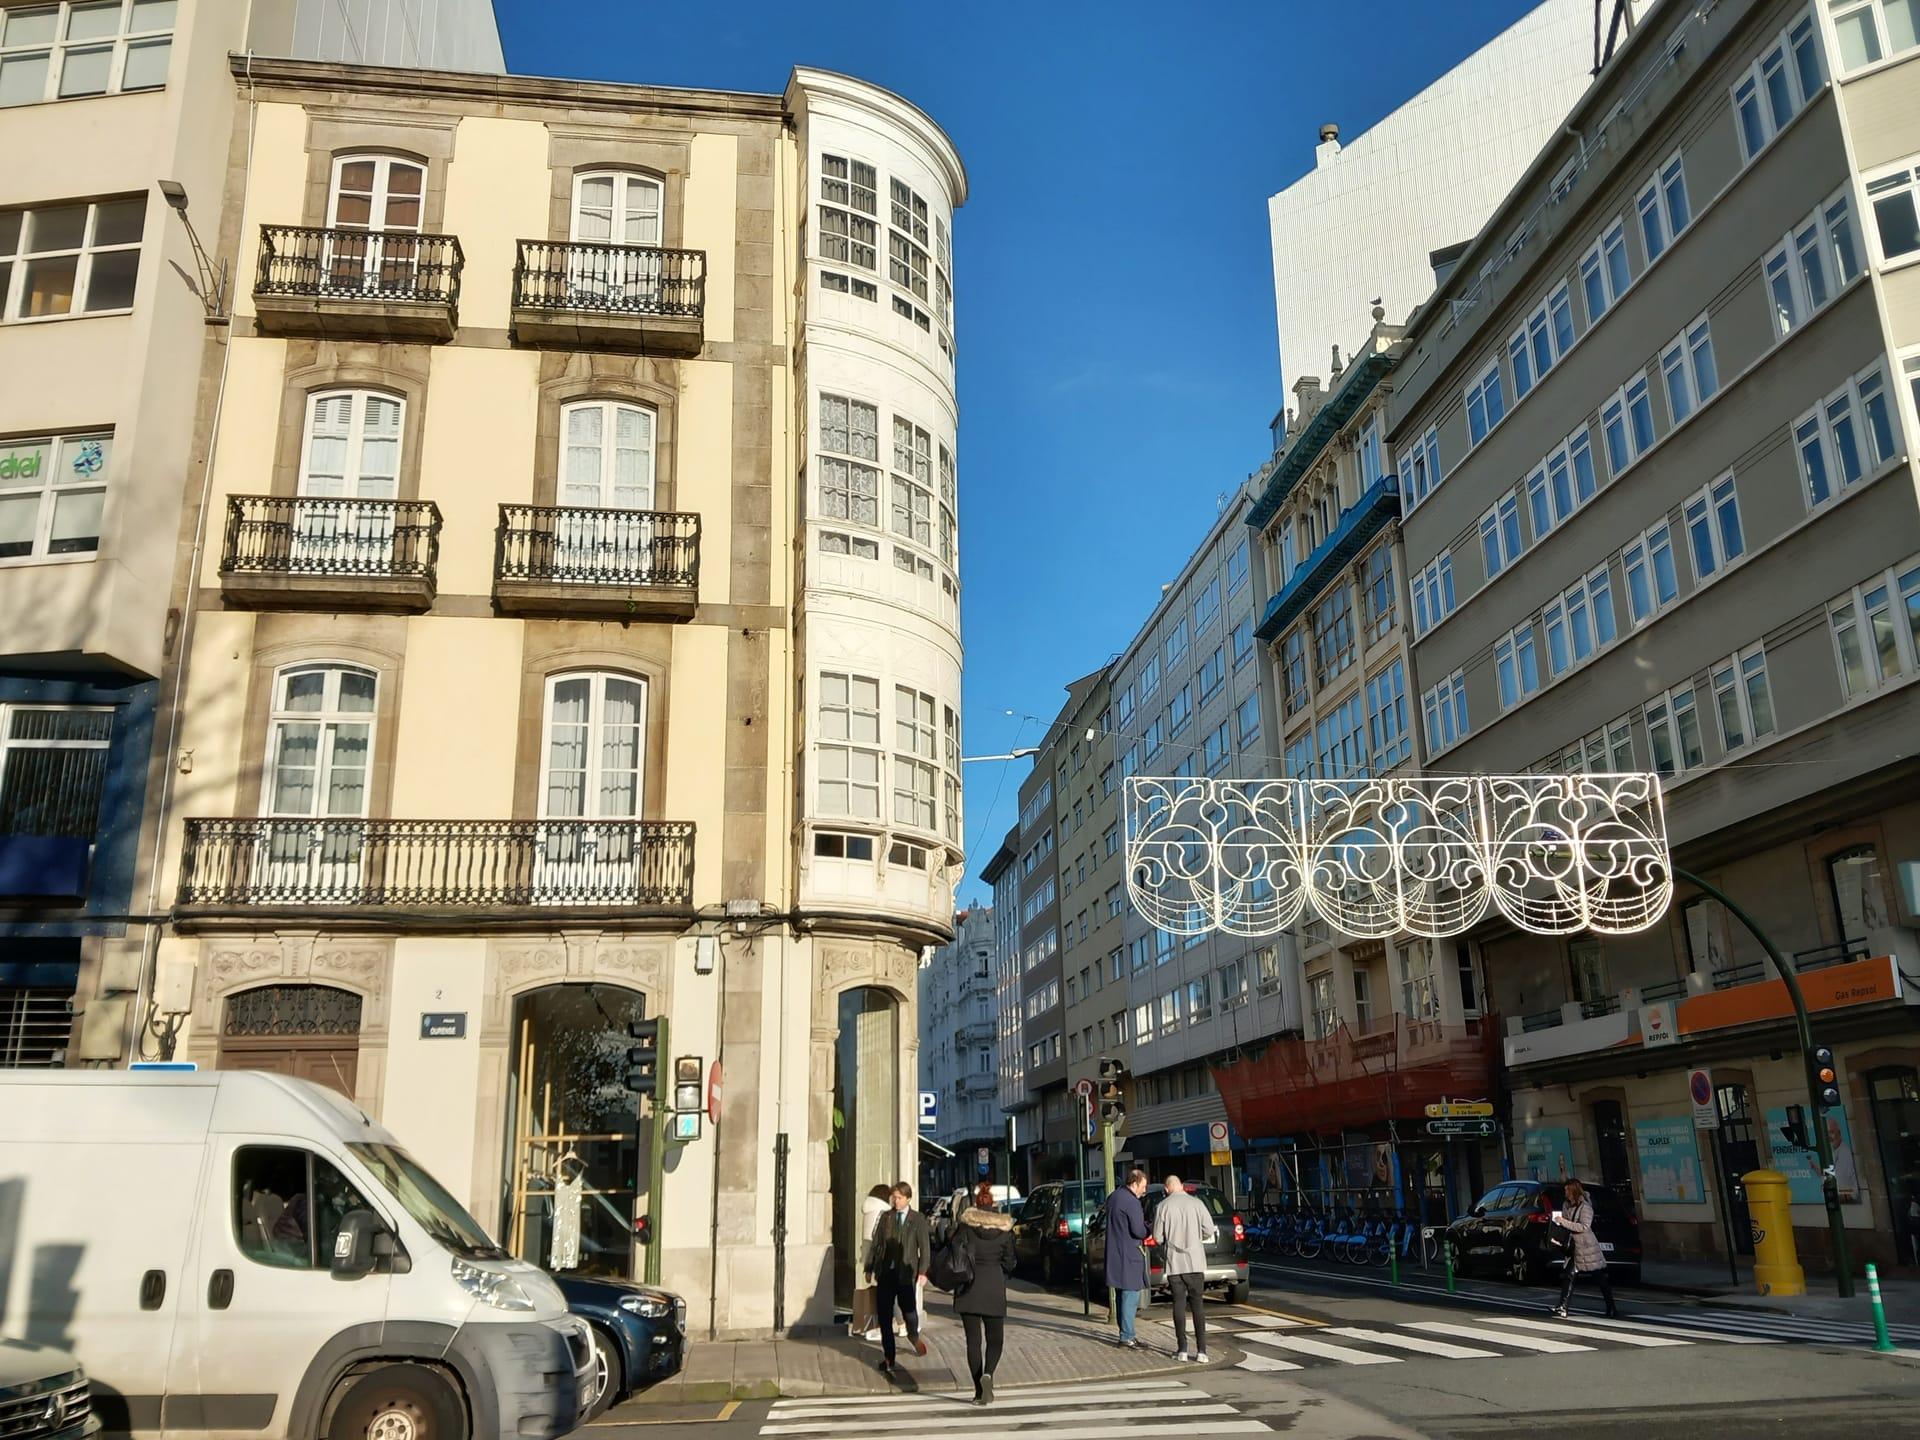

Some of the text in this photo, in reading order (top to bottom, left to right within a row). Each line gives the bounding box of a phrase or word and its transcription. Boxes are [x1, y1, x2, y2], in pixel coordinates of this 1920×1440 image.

[435, 989, 442, 1000] 2
[1835, 984, 1877, 1000] Gas Repsol
[1648, 1032, 1669, 1042] REPSOL
[919, 1092, 936, 1116] P
[1648, 1136, 1670, 1146] OLAPLEX
